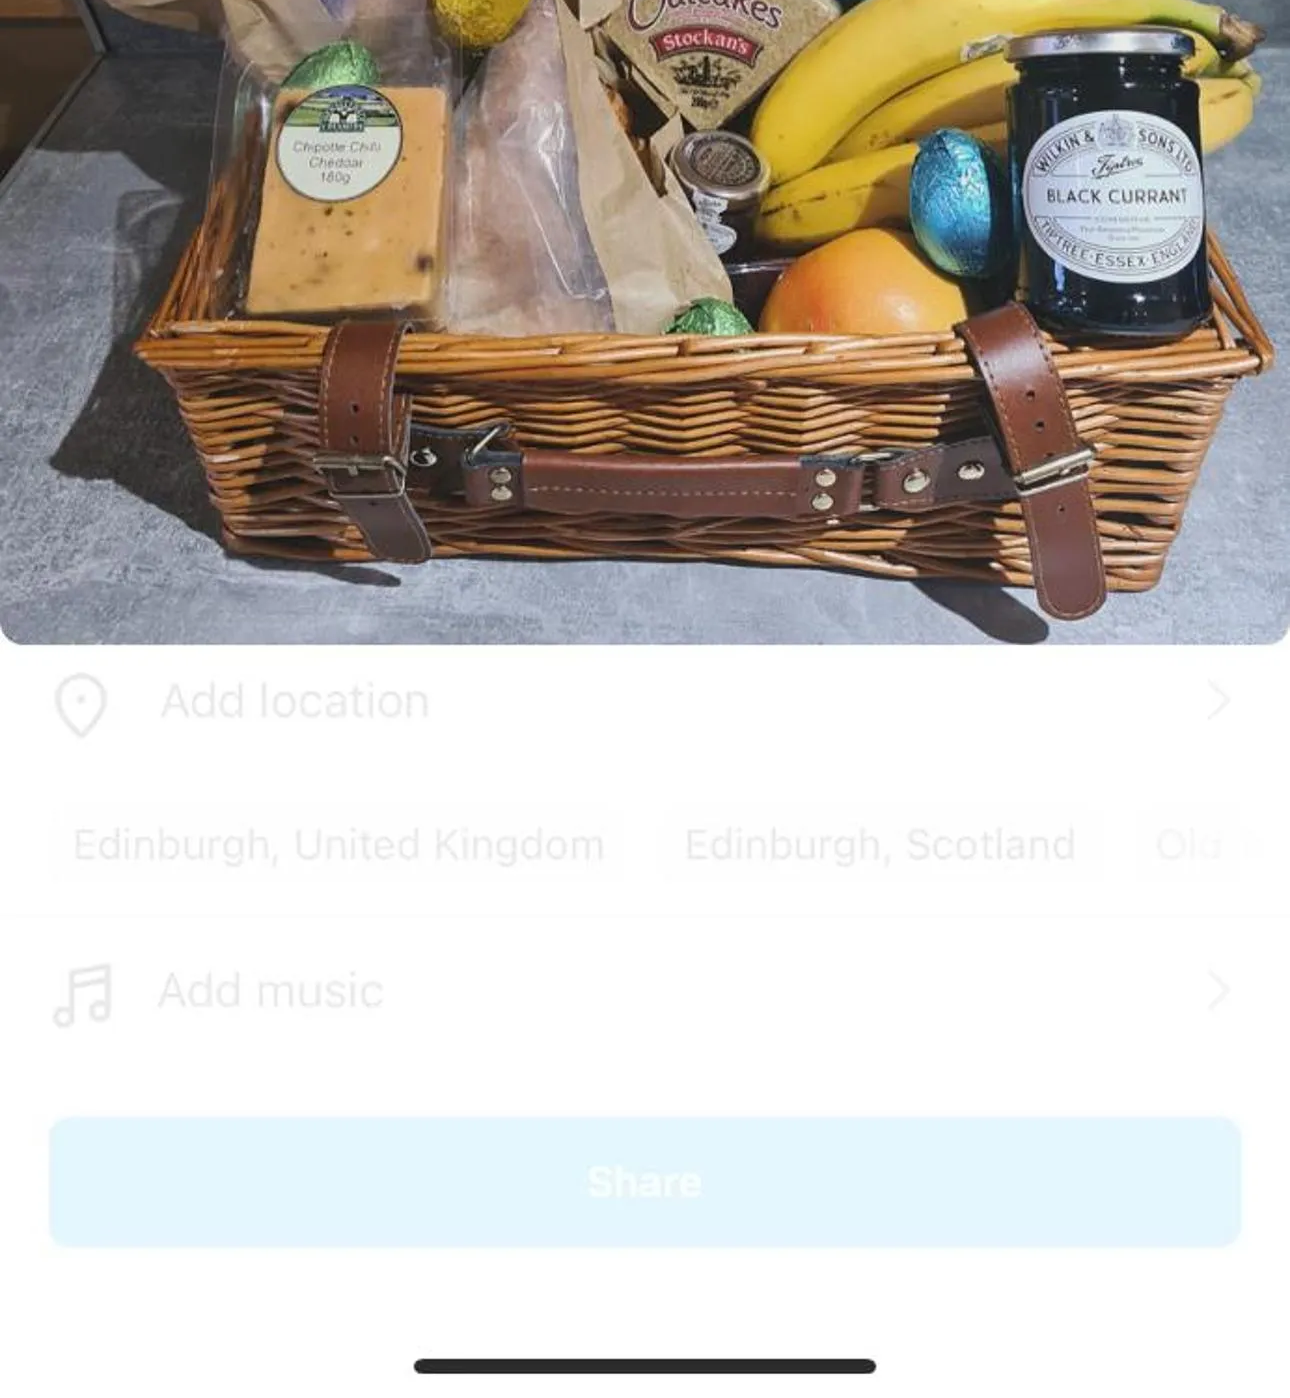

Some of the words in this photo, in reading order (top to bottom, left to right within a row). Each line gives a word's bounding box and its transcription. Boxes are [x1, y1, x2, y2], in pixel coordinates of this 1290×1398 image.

[662, 29, 751, 55] Stockan's
[292, 139, 346, 154] Chipotle
[308, 155, 364, 170] Cheddar
[1035, 133, 1081, 172] WILKIN
[1084, 130, 1095, 143] &
[1138, 128, 1175, 154] SONS
[1046, 188, 1101, 204] BLACK
[1108, 187, 1188, 204] CURRANT
[160, 681, 246, 719] Add
[260, 680, 430, 720] location
[75, 826, 279, 868] Edinburgh,
[295, 826, 421, 862] United
[435, 826, 604, 868] Kingdom
[686, 826, 892, 868] Edinburgh,
[907, 826, 1075, 862] Scotland
[157, 970, 242, 1009] Add
[258, 970, 384, 1009] music
[587, 1165, 702, 1199] Share
